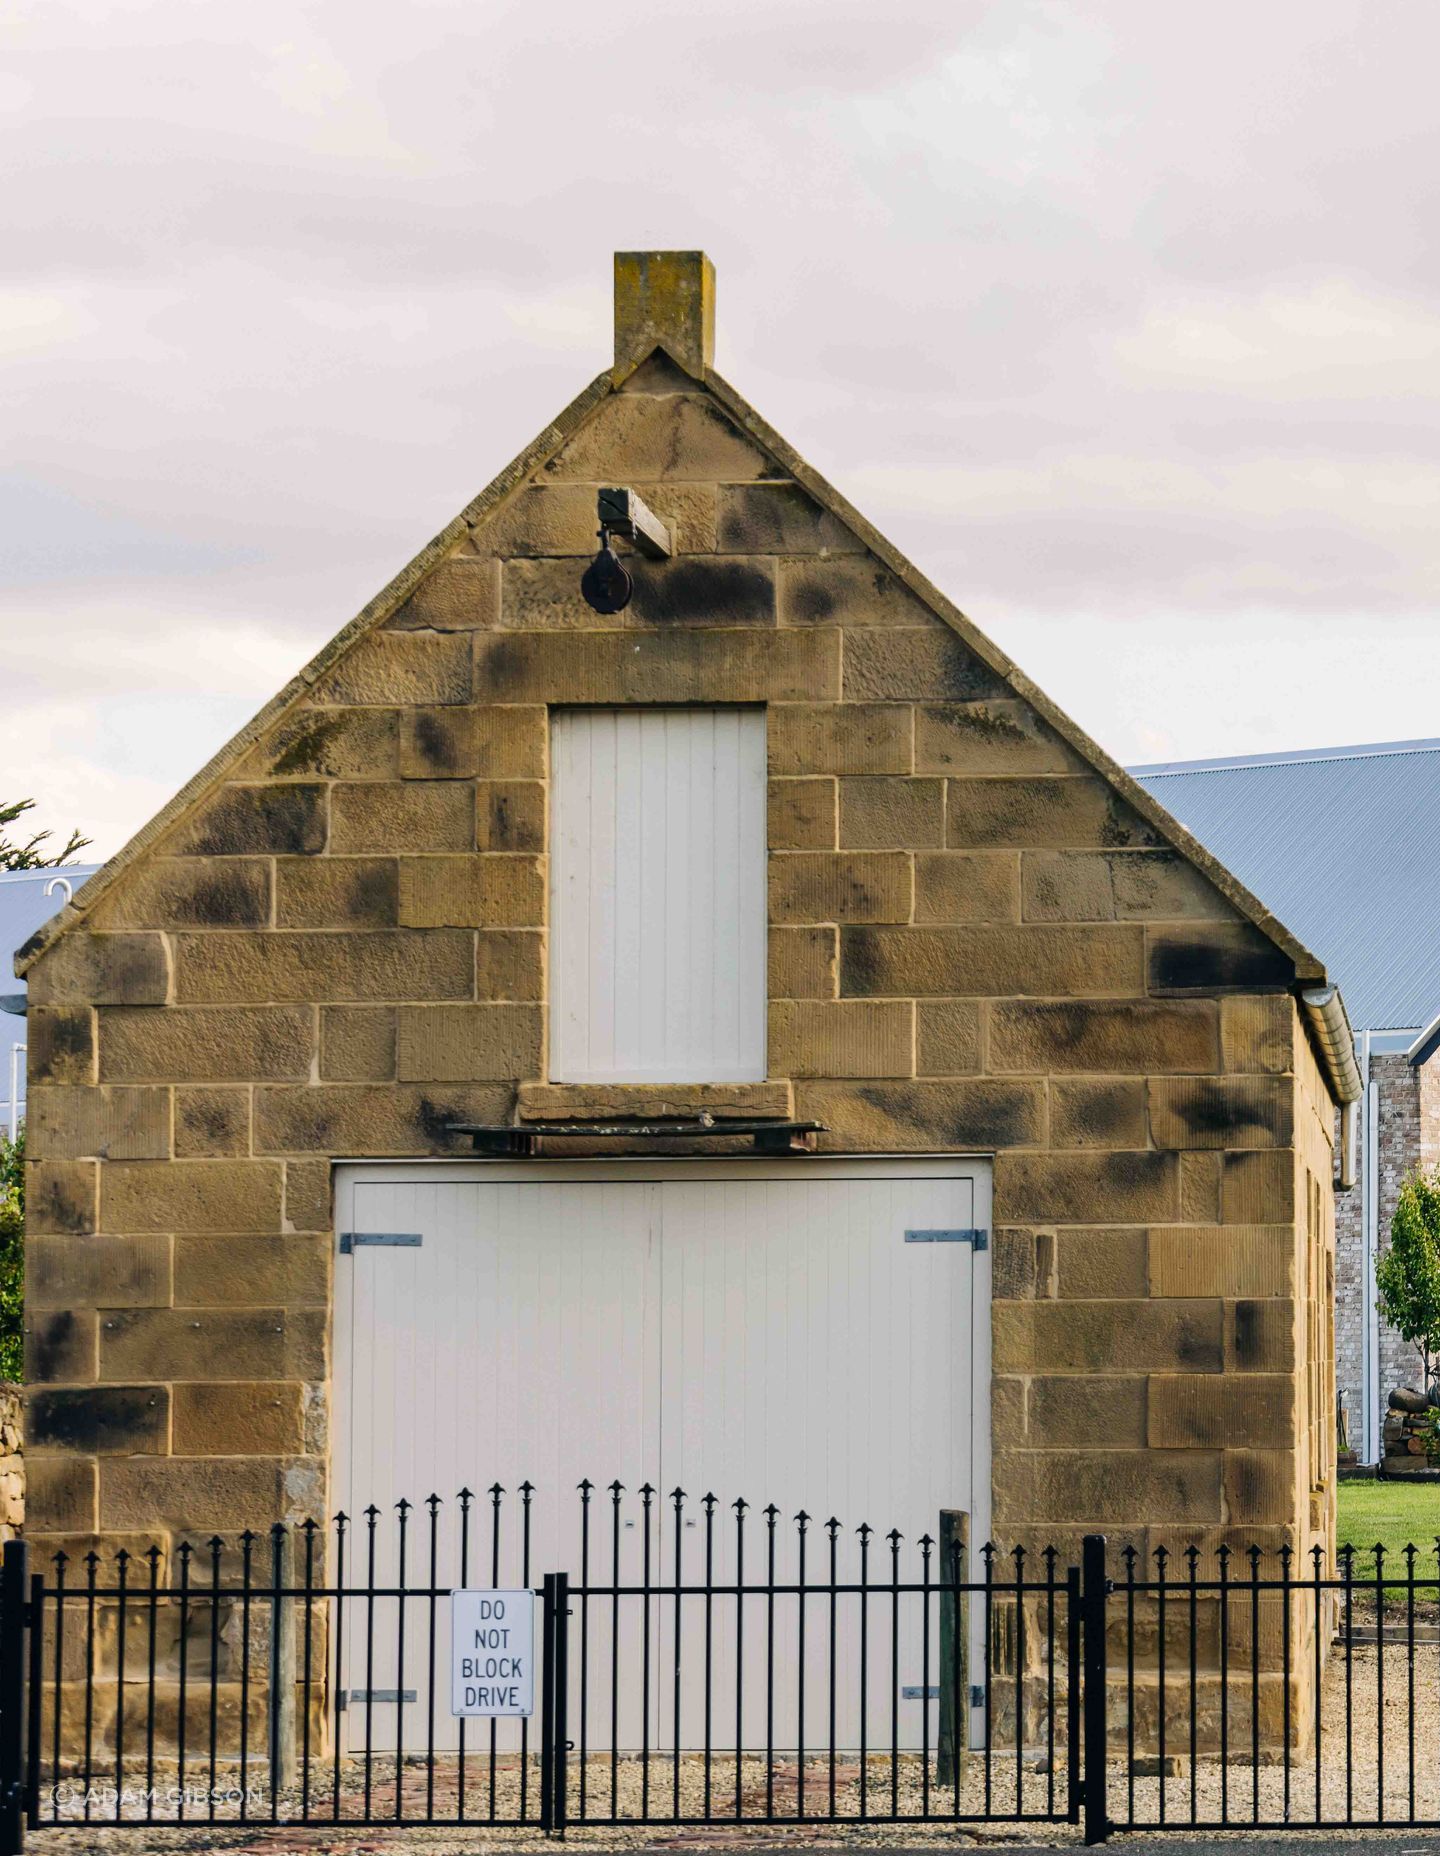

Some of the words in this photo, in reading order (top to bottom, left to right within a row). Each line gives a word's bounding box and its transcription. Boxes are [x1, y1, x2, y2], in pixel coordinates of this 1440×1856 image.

[481, 1600, 505, 1620] DO
[475, 1629, 510, 1649] NOT
[462, 1658, 522, 1678] BLOCK
[465, 1687, 519, 1707] DRIVE
